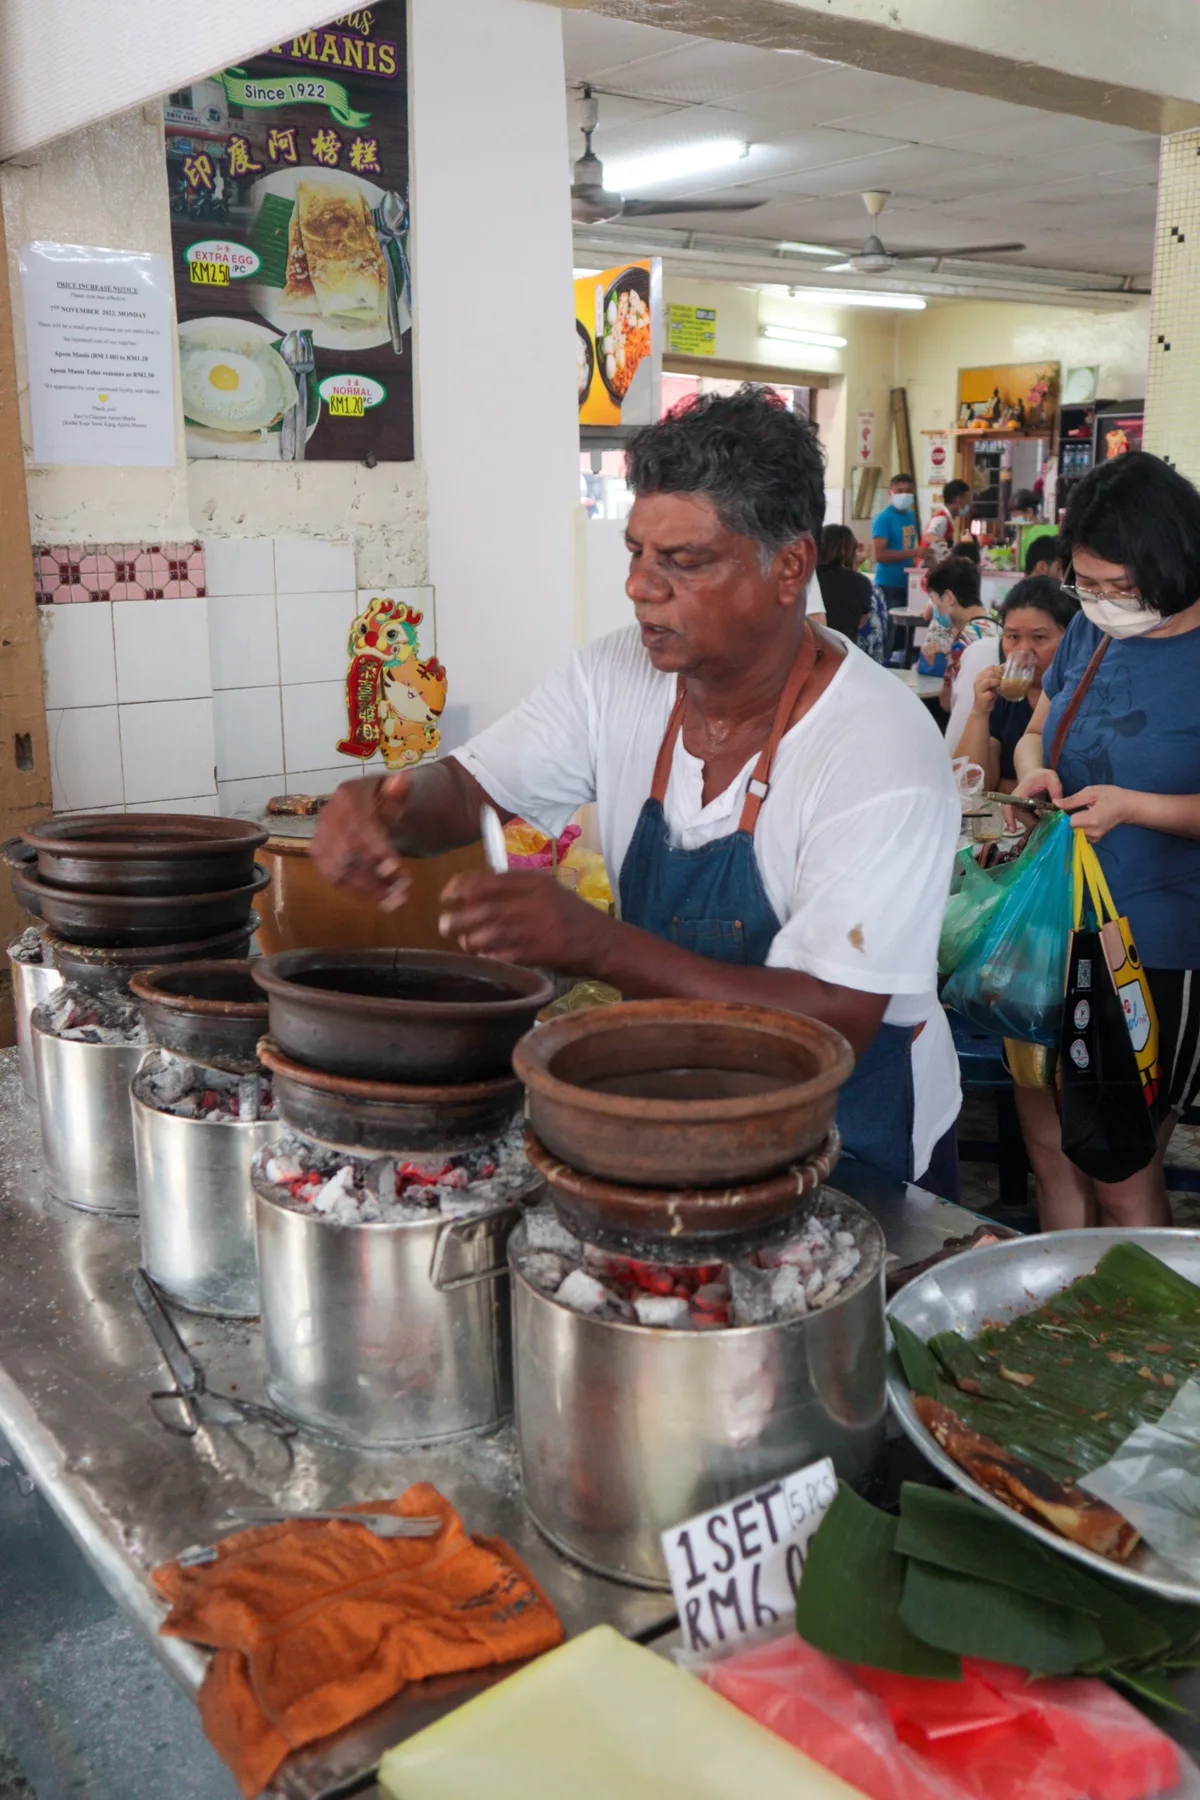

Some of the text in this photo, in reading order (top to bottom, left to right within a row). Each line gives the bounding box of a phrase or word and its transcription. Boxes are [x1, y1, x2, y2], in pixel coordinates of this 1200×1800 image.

[291, 30, 397, 75] MANIS
[245, 83, 325, 100] Since 1922
[195, 251, 253, 265] EXTRA EGG
[56, 281, 139, 295] PRICE INCREASE NOTICE
[61, 307, 100, 315] NOVEMBER
[118, 311, 147, 319] MONDAY
[333, 386, 373, 396] NORMAL
[330, 396, 364, 414] RM1.20
[677, 1530, 707, 1589] 1
[707, 1483, 782, 1574] SET
